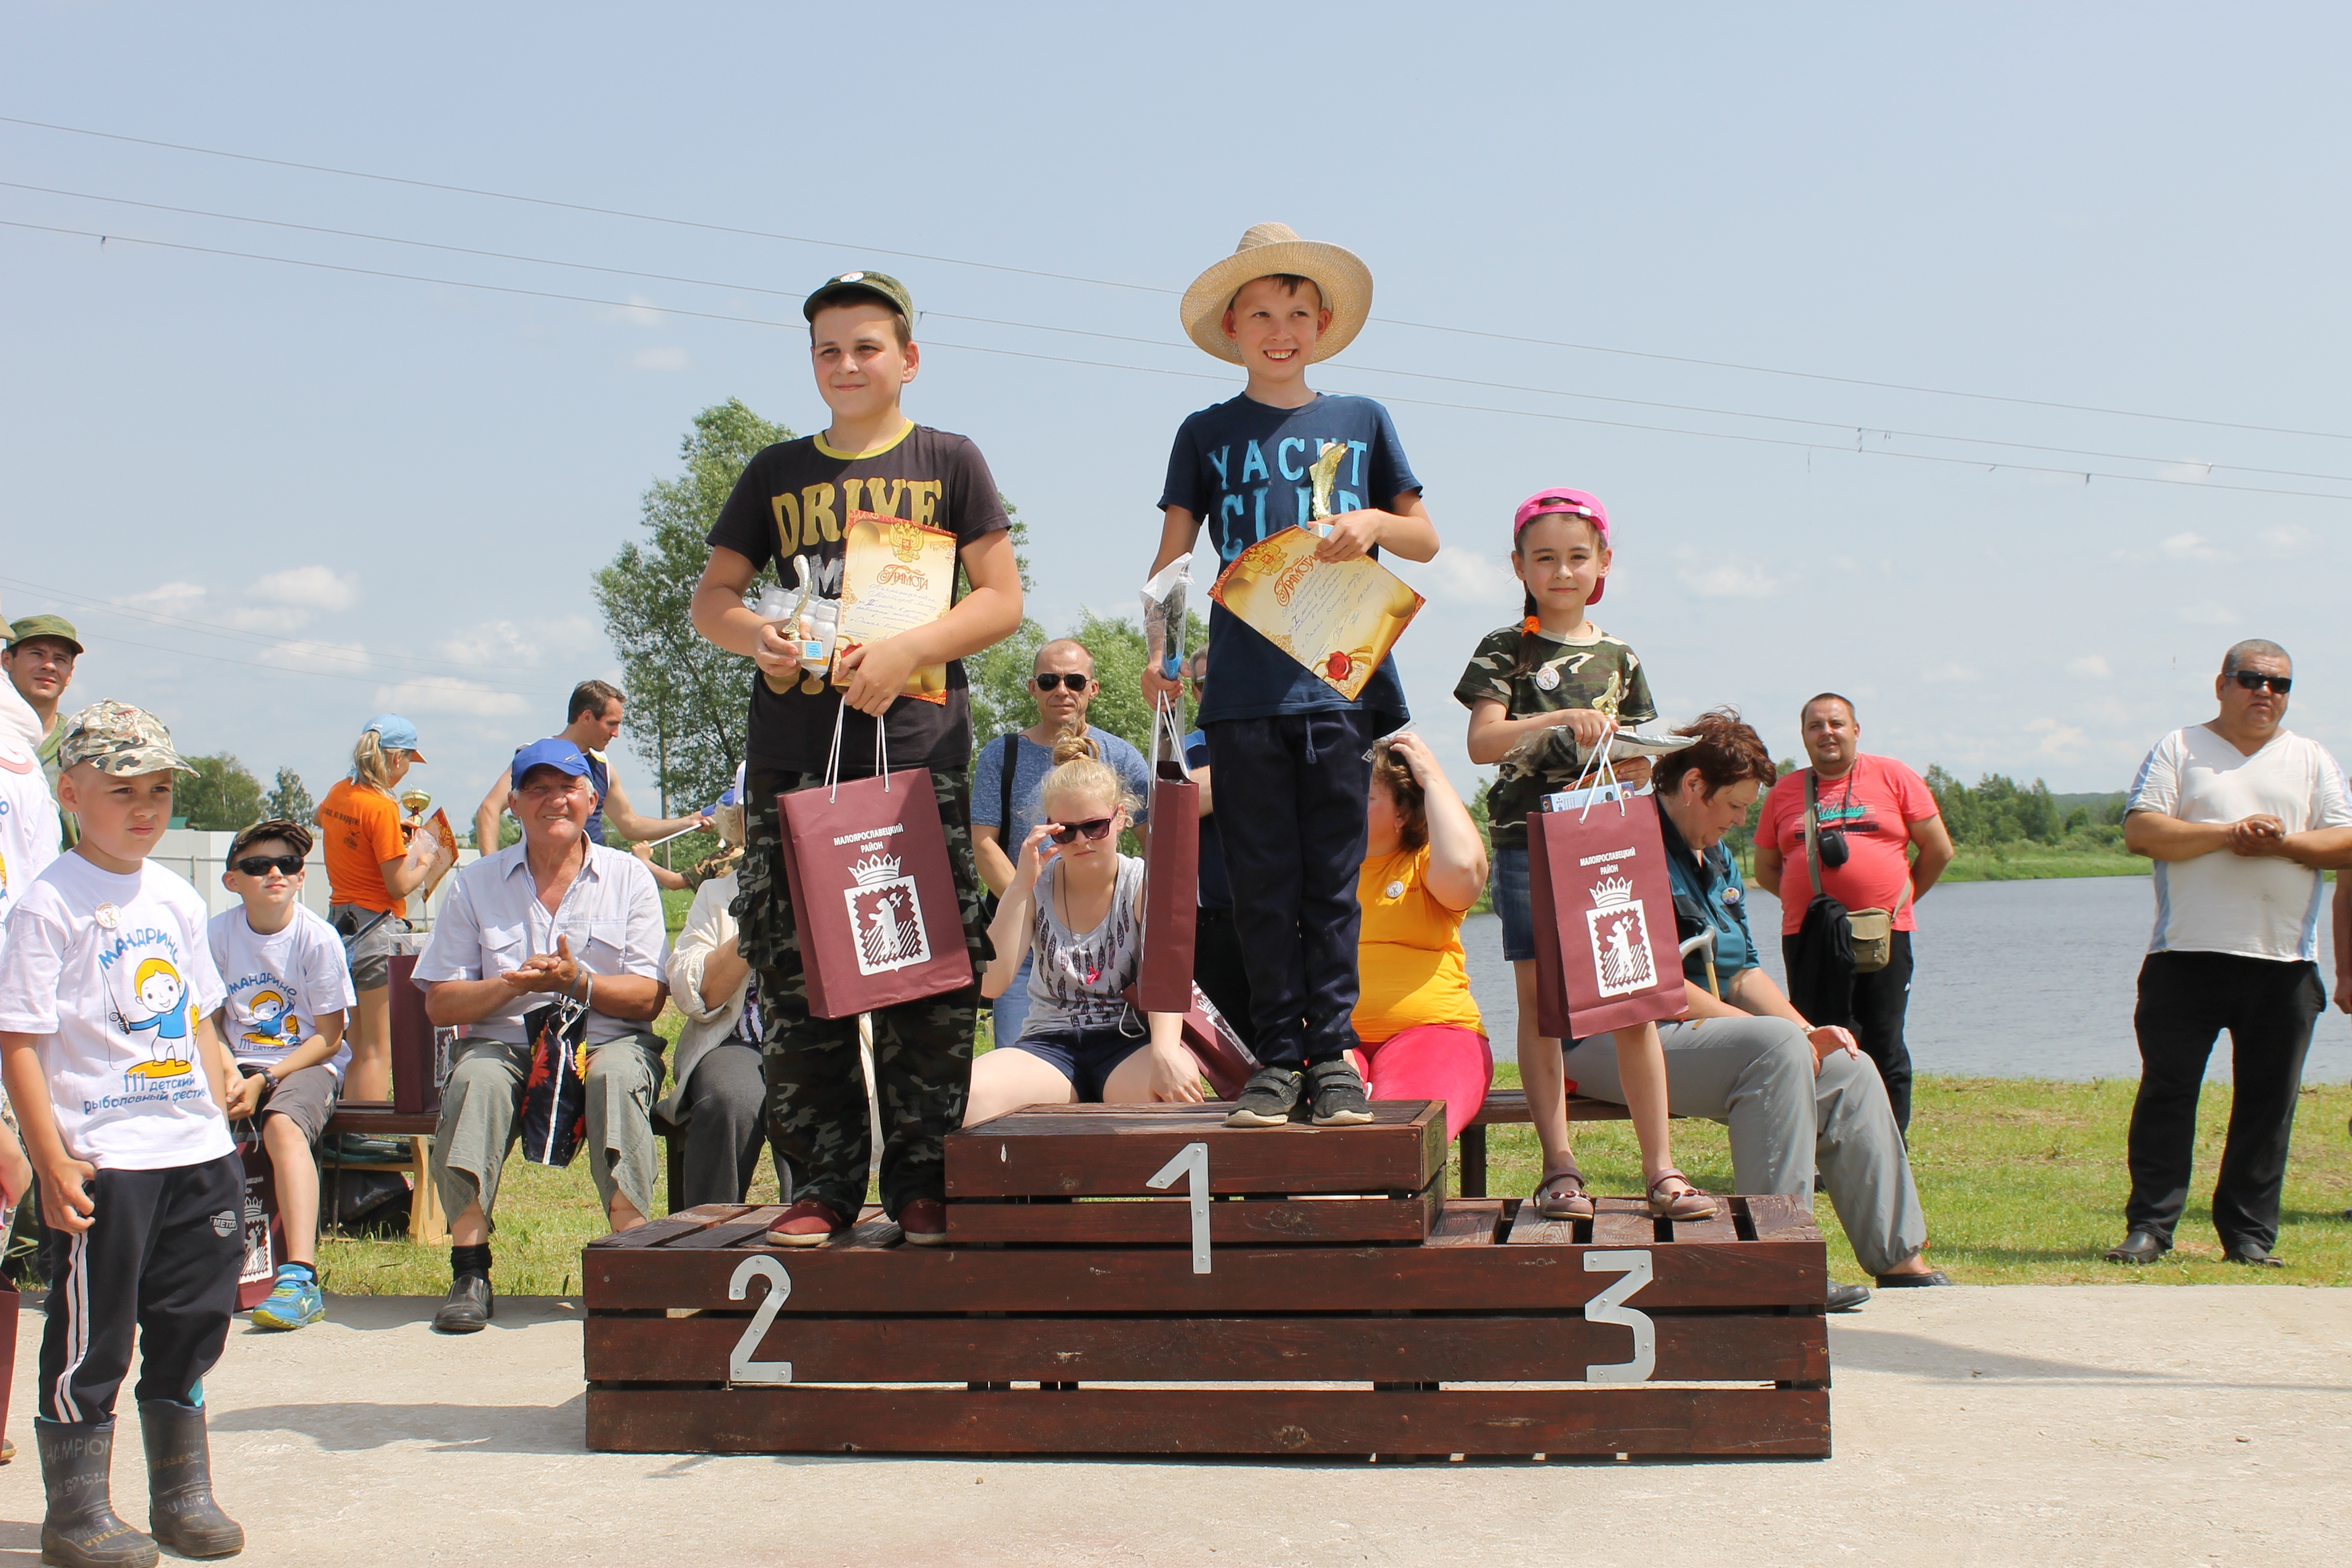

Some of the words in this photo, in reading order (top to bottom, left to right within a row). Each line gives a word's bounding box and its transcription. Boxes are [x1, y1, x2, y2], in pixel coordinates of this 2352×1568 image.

[1207, 437, 1368, 491] YACT
[771, 477, 943, 558] DRIVE
[834, 823, 904, 846] МАЛОЯРОСЛАВЕЦКИЙ
[861, 841, 884, 853] РАЙОН
[1579, 846, 1636, 867] МАЛОЯРОСЛАВЕЦКИЙ
[1599, 864, 1619, 875] РАЙОН
[228, 973, 297, 995] МАНДРИНО
[149, 1073, 195, 1092] детский
[84, 1091, 168, 1114] рыболовный
[1146, 1142, 1211, 1274] 1
[213, 1218, 236, 1228] METCO
[728, 1254, 792, 1382] 2
[1583, 1250, 1656, 1382] 3
